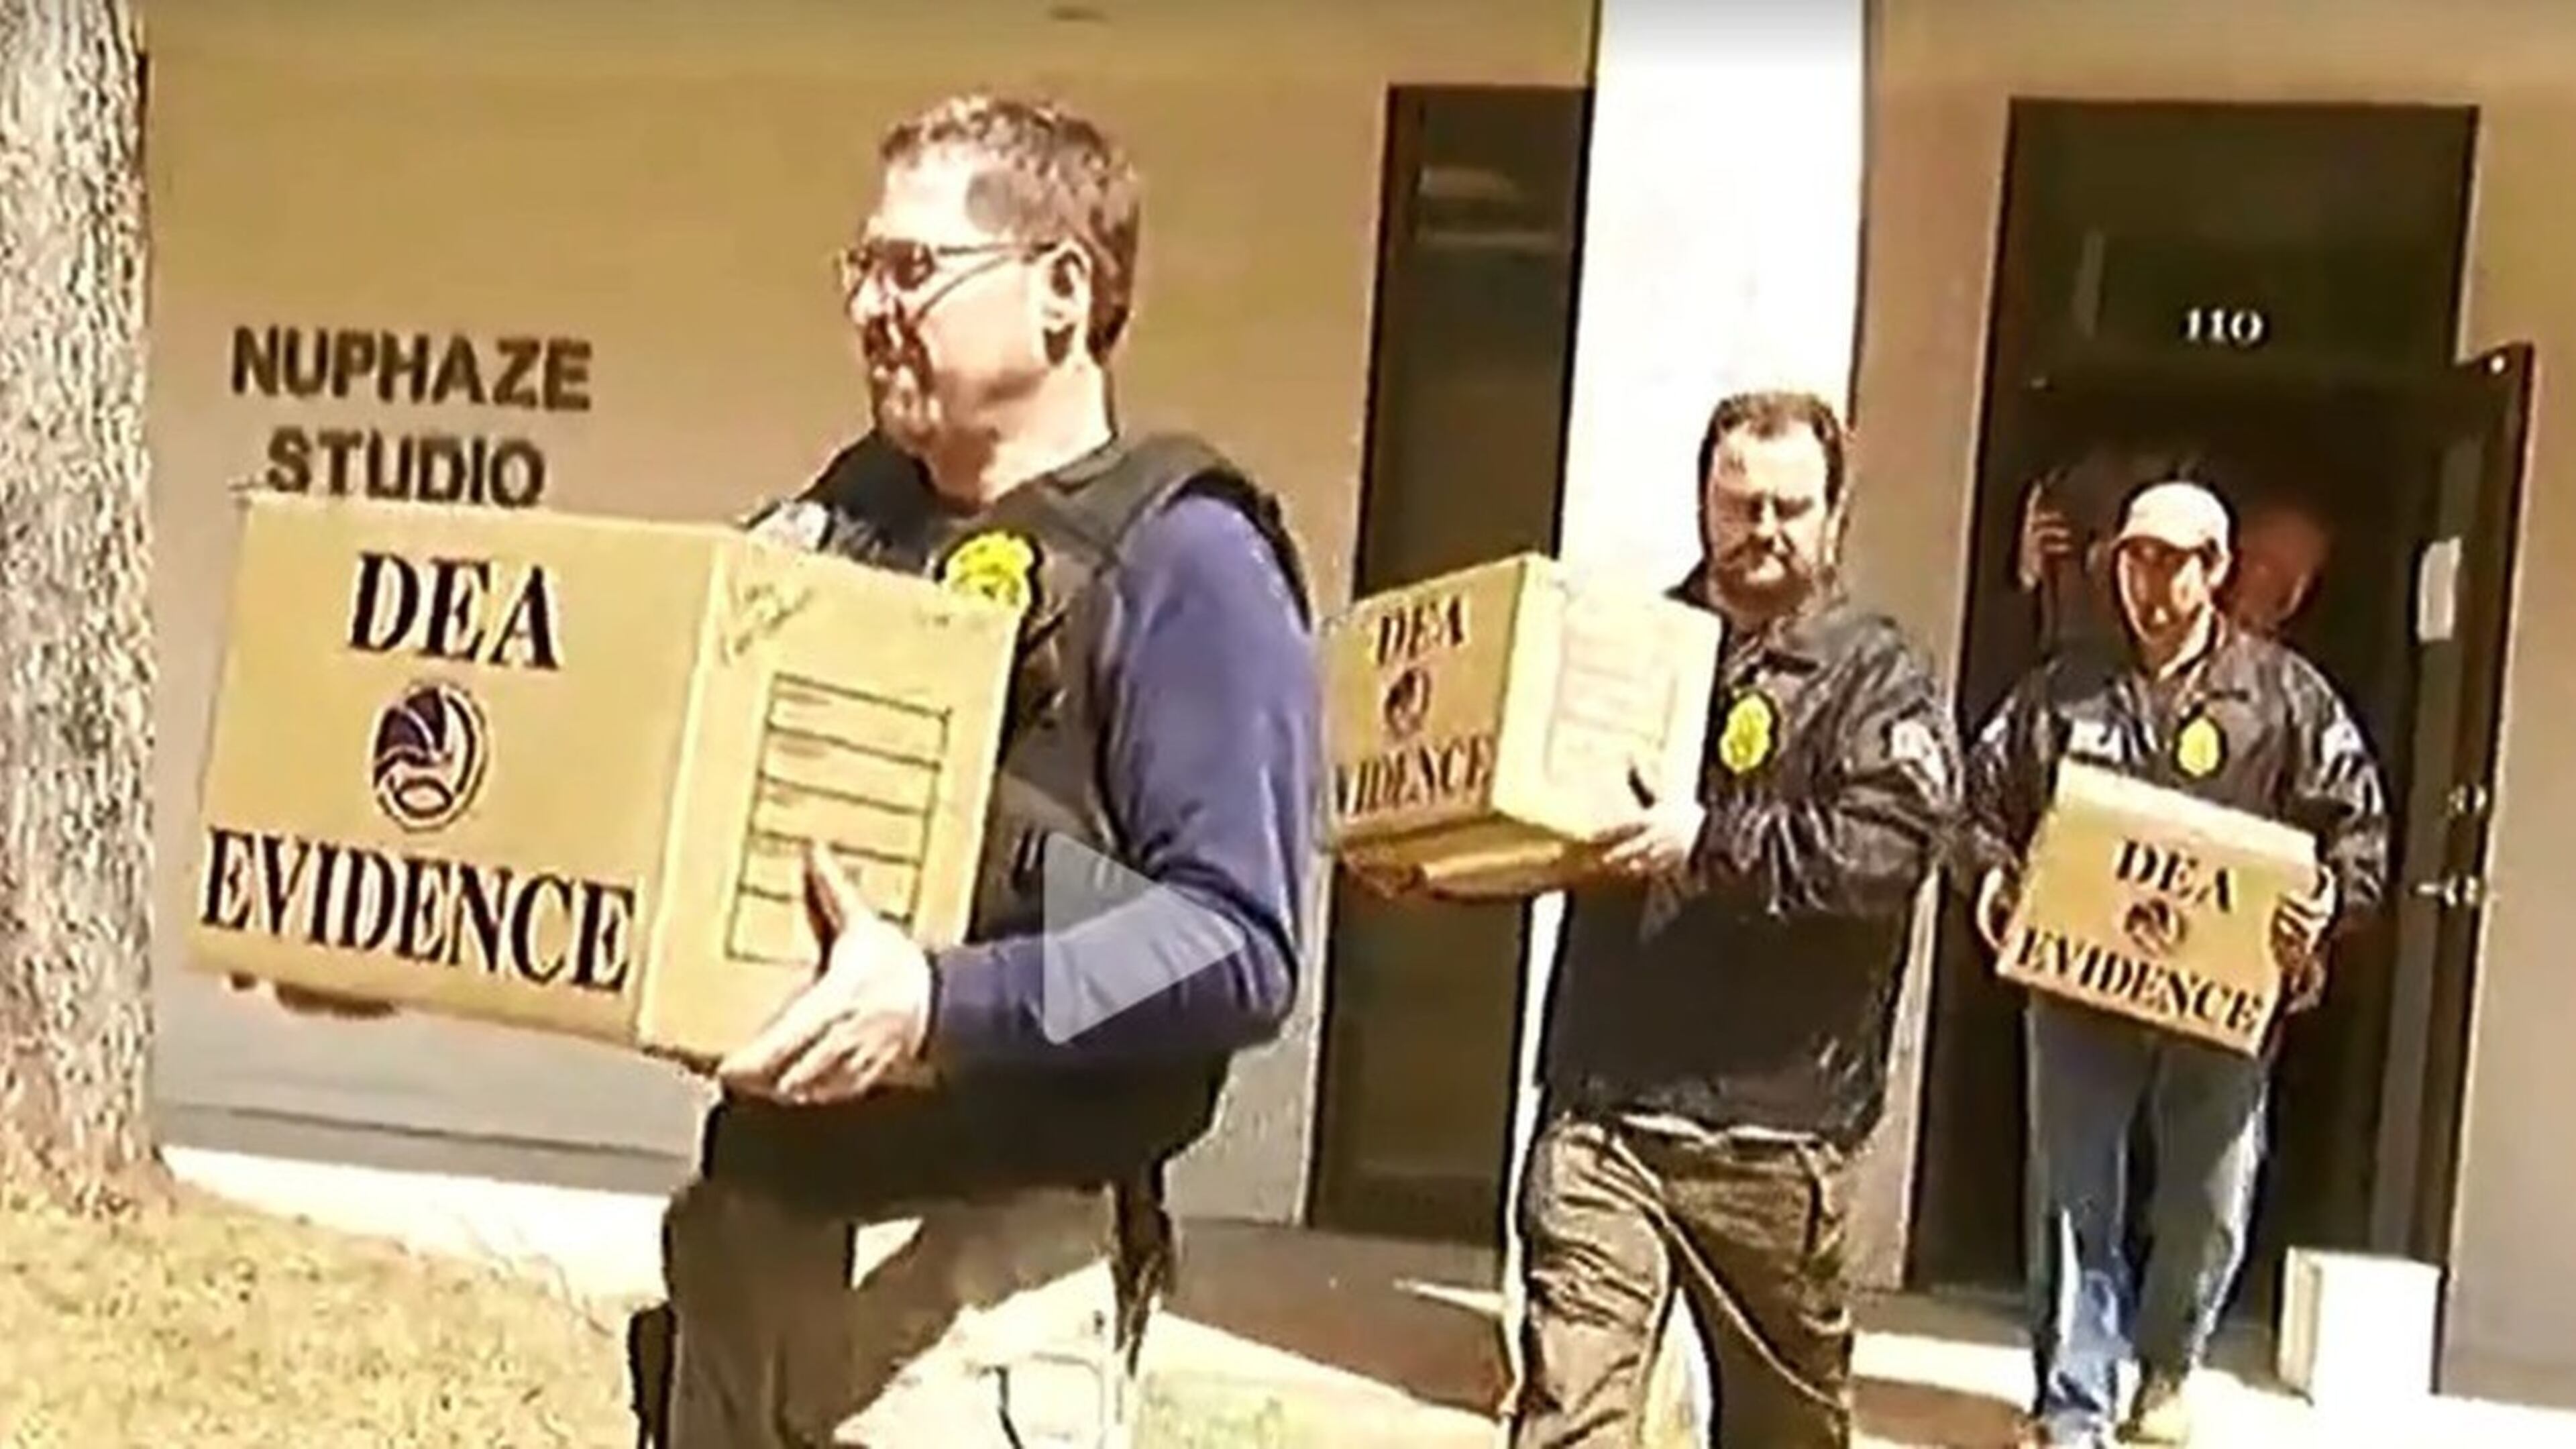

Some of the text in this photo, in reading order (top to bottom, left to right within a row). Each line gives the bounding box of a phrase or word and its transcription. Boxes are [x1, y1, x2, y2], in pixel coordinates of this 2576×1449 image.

[2187, 307, 2263, 343] 110
[231, 325, 592, 412] NUPHAZE
[266, 427, 545, 507] STUDIO
[347, 550, 560, 671] DEA
[1375, 594, 1465, 668] DEA
[201, 825, 636, 994] EVIDENCE
[2116, 839, 2231, 914] DEA
[2015, 926, 2264, 1035] EVIDENCE
